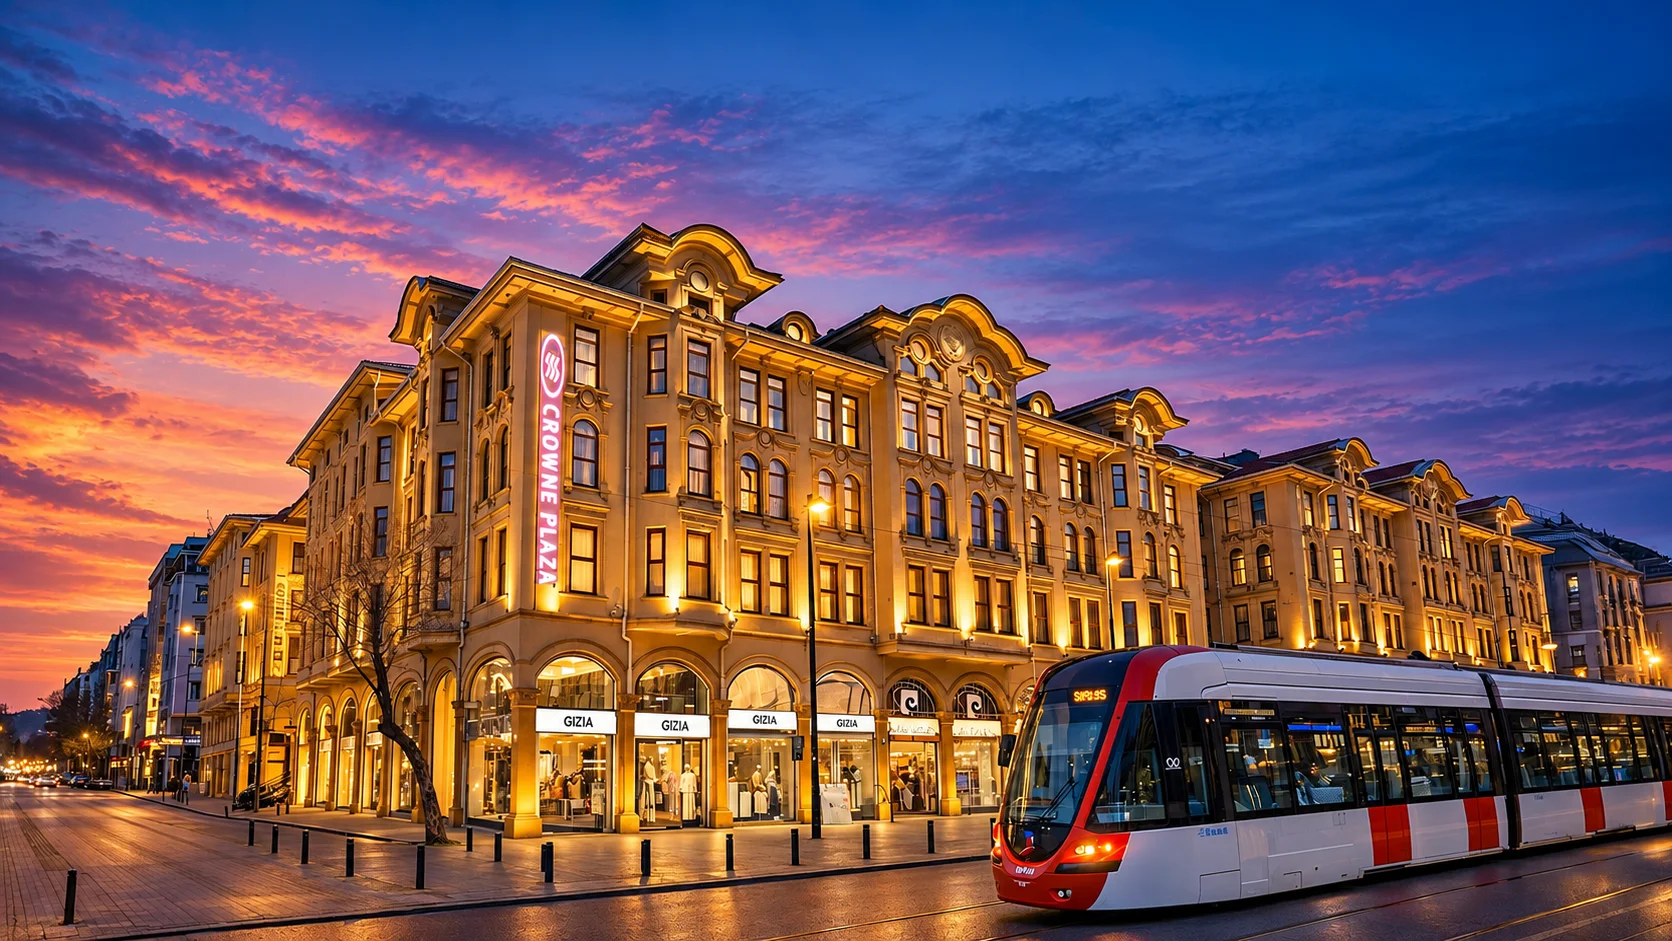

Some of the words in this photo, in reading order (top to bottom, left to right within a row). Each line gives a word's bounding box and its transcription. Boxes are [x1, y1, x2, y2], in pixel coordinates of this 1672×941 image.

[542, 404, 560, 505] CROWNE
[537, 513, 558, 584] PLAZA
[563, 715, 594, 728] GIZIA
[661, 719, 689, 732] GIZIA
[752, 714, 777, 725] GIZIA
[836, 718, 858, 728] GIZIA
